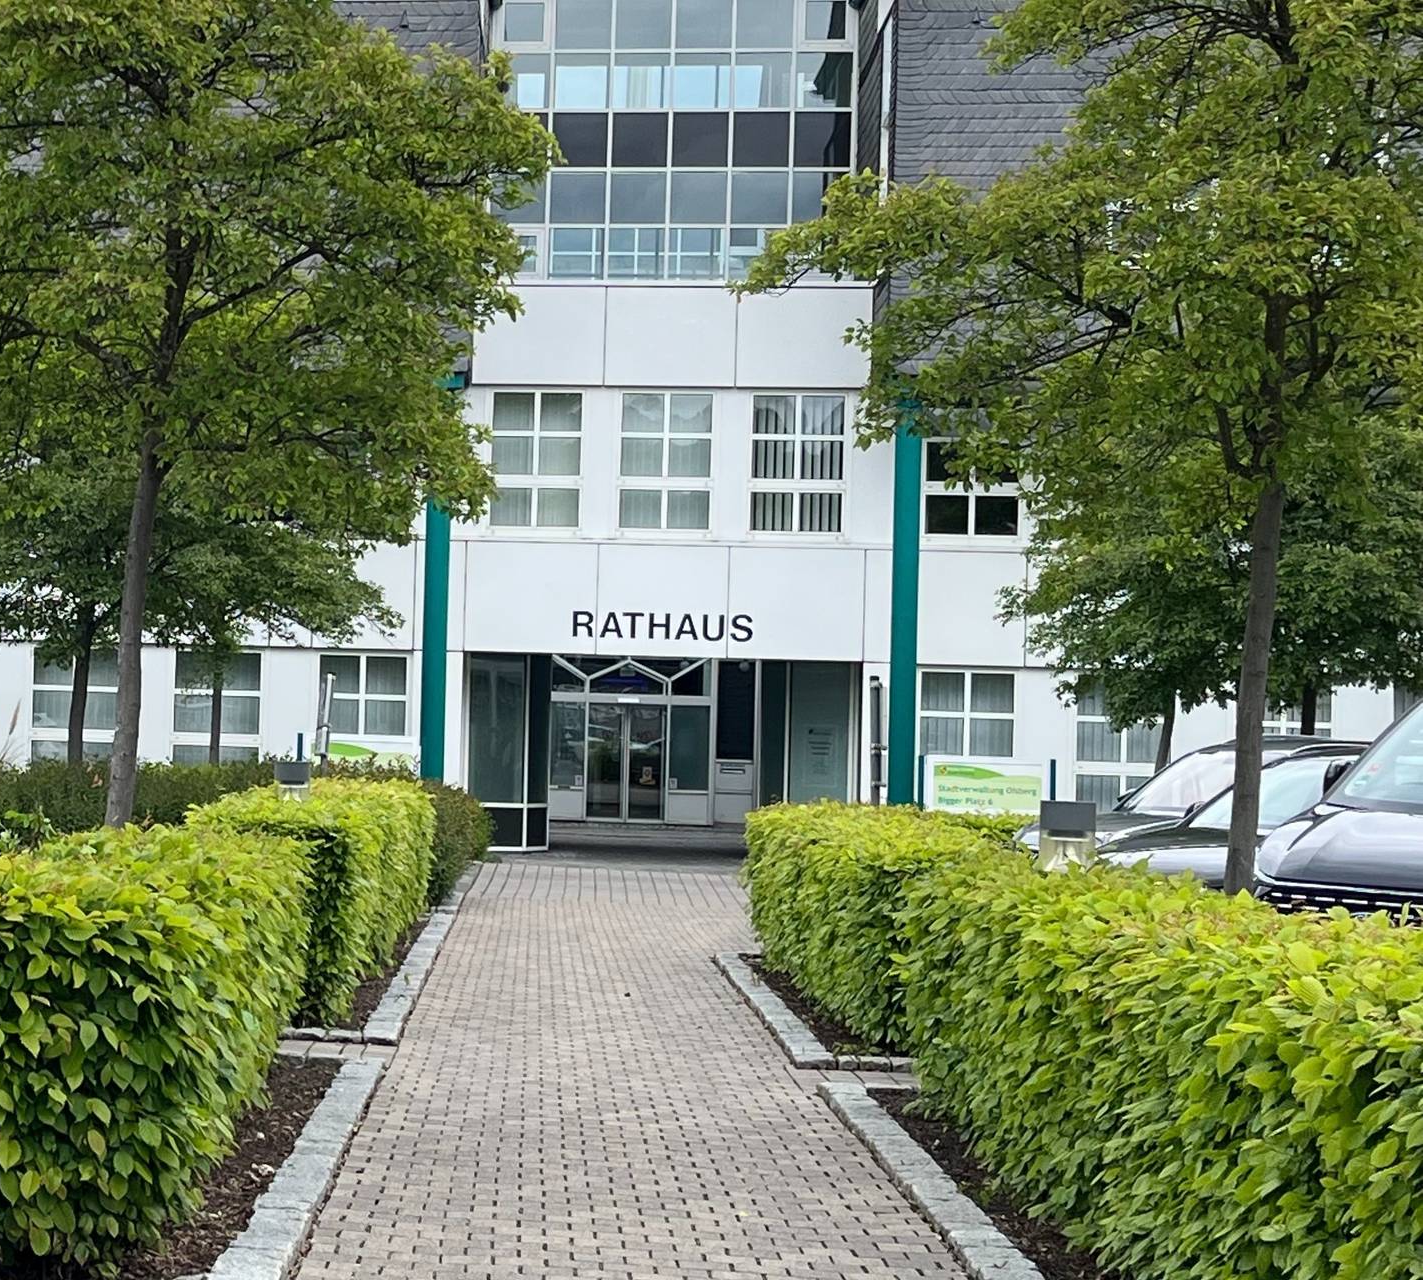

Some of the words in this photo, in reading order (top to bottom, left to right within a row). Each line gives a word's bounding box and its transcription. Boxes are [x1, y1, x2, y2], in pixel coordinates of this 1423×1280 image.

[572, 611, 753, 642] RATHAUS
[938, 785, 1004, 796] Stadtverwaltung
[1006, 787, 1037, 796] Olsberg
[938, 797, 962, 805] Bigger
[965, 797, 985, 805] Platz
